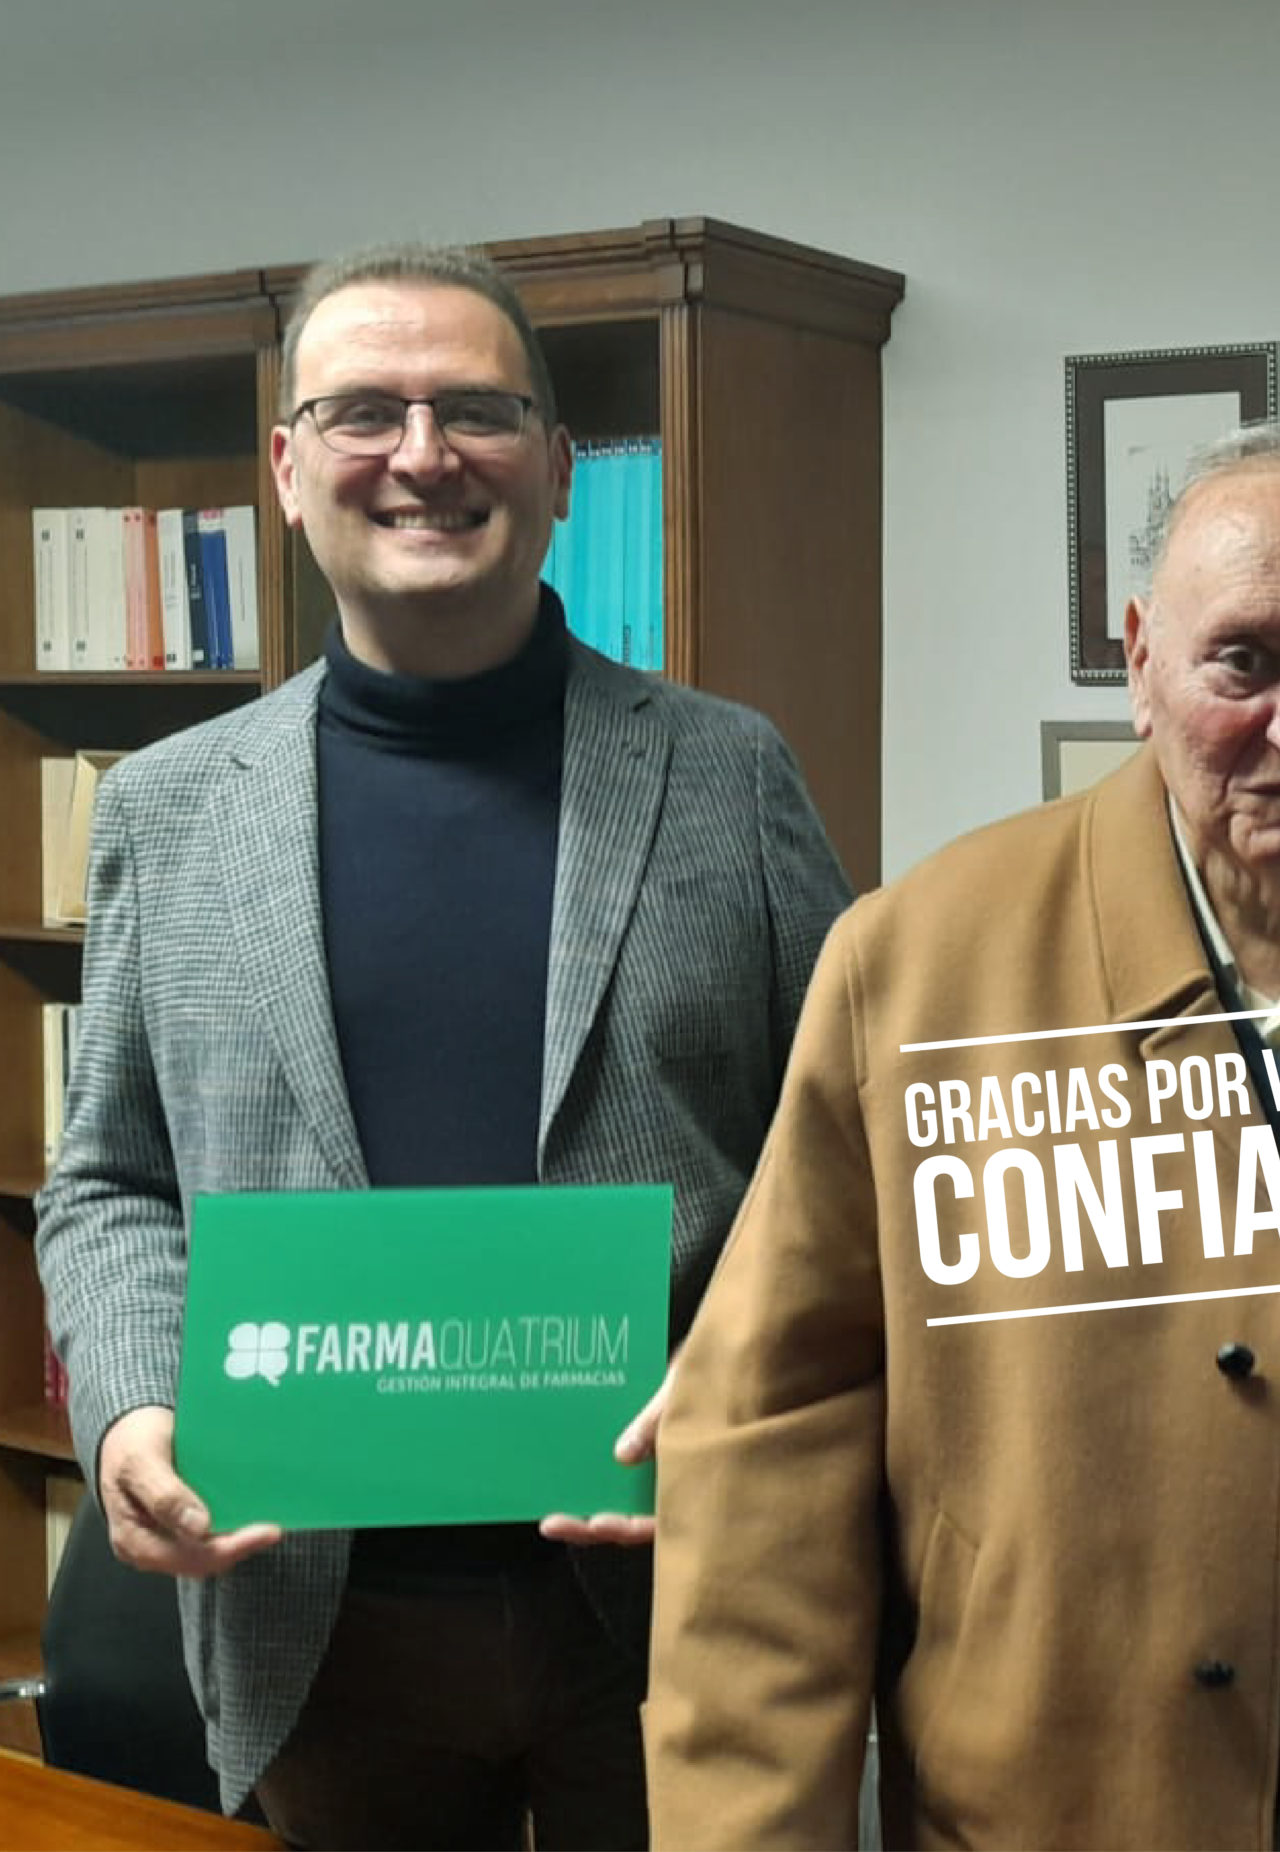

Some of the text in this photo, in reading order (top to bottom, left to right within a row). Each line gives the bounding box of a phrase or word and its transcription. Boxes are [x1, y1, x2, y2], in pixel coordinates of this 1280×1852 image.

[296, 1314, 630, 1375] FARMAQUATRIUM
[377, 1370, 627, 1393] GESTIÓN INTEGRAL DE FARMACIAS
